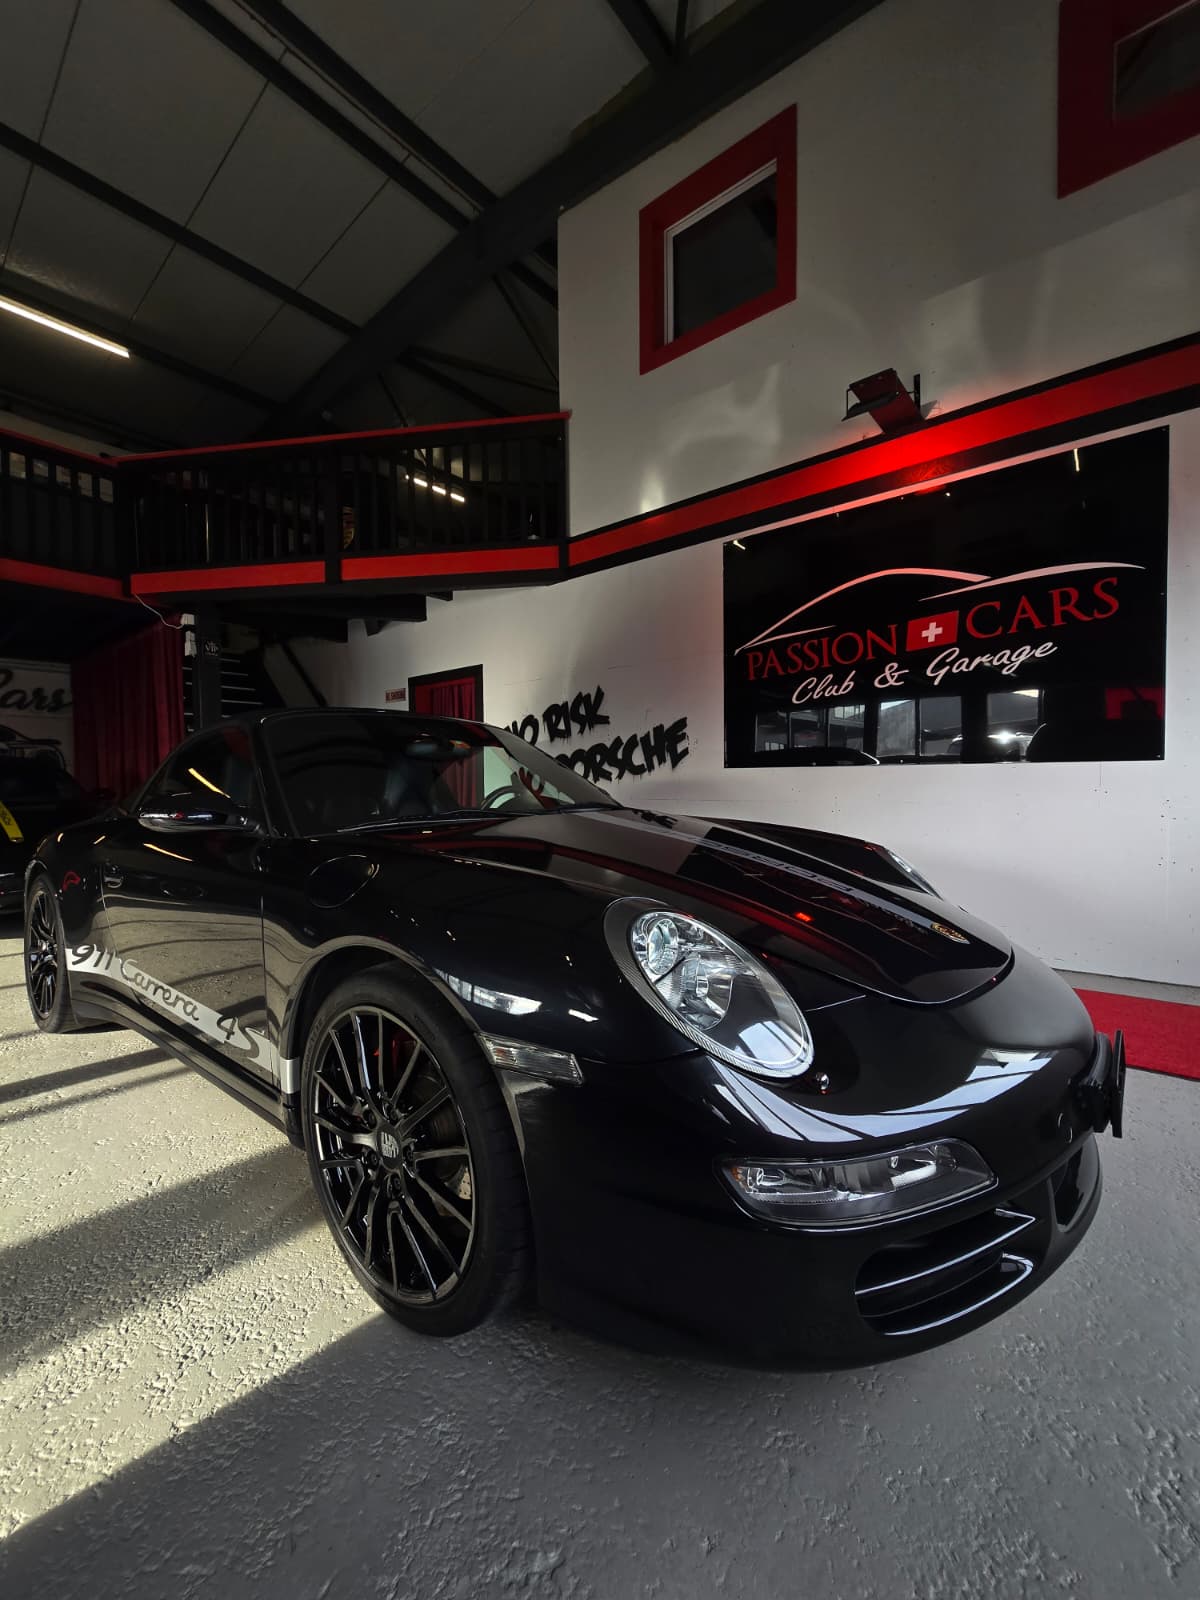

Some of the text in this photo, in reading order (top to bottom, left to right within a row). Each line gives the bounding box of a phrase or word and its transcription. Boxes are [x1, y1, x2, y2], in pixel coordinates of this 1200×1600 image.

[747, 577, 1120, 681] PASSION CARS
[543, 685, 610, 742] RISK
[792, 640, 1058, 704] Club & Garage
[71, 944, 117, 970] 911
[119, 958, 199, 1021] Carrera
[216, 1015, 266, 1059] 4S
